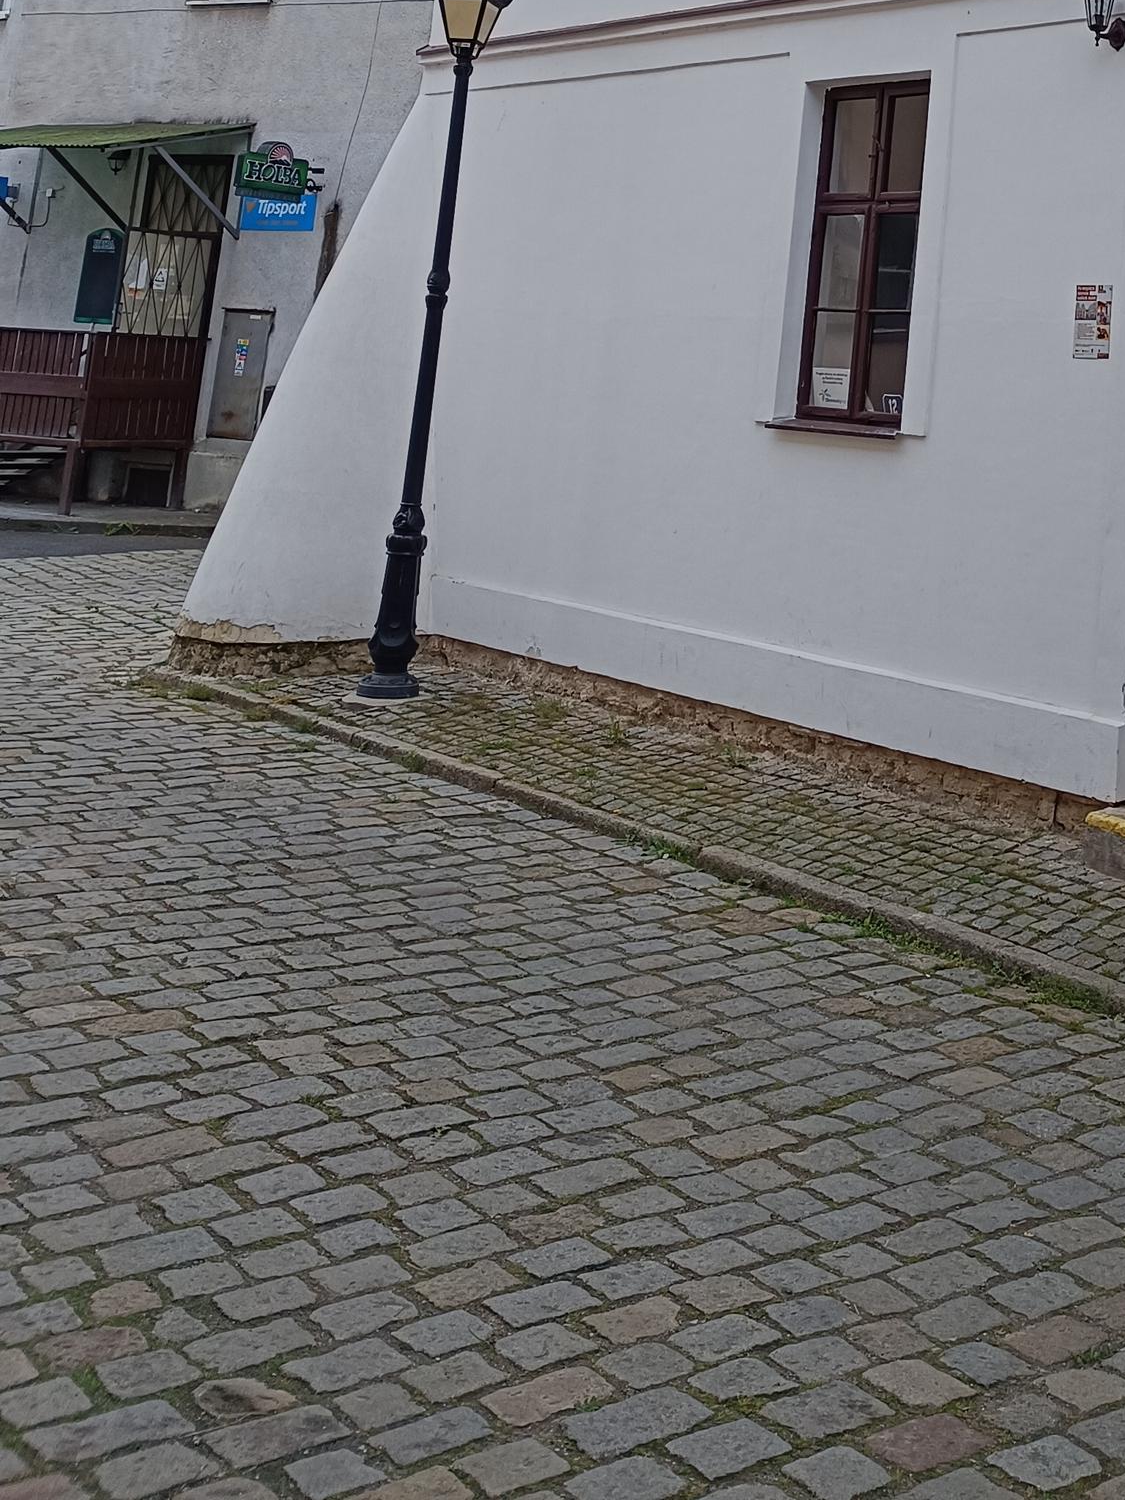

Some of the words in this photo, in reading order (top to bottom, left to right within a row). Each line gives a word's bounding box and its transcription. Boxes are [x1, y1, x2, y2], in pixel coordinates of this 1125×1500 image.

[243, 159, 303, 188] HOLBA
[257, 199, 307, 218] Tipsport
[887, 398, 899, 414] 12
